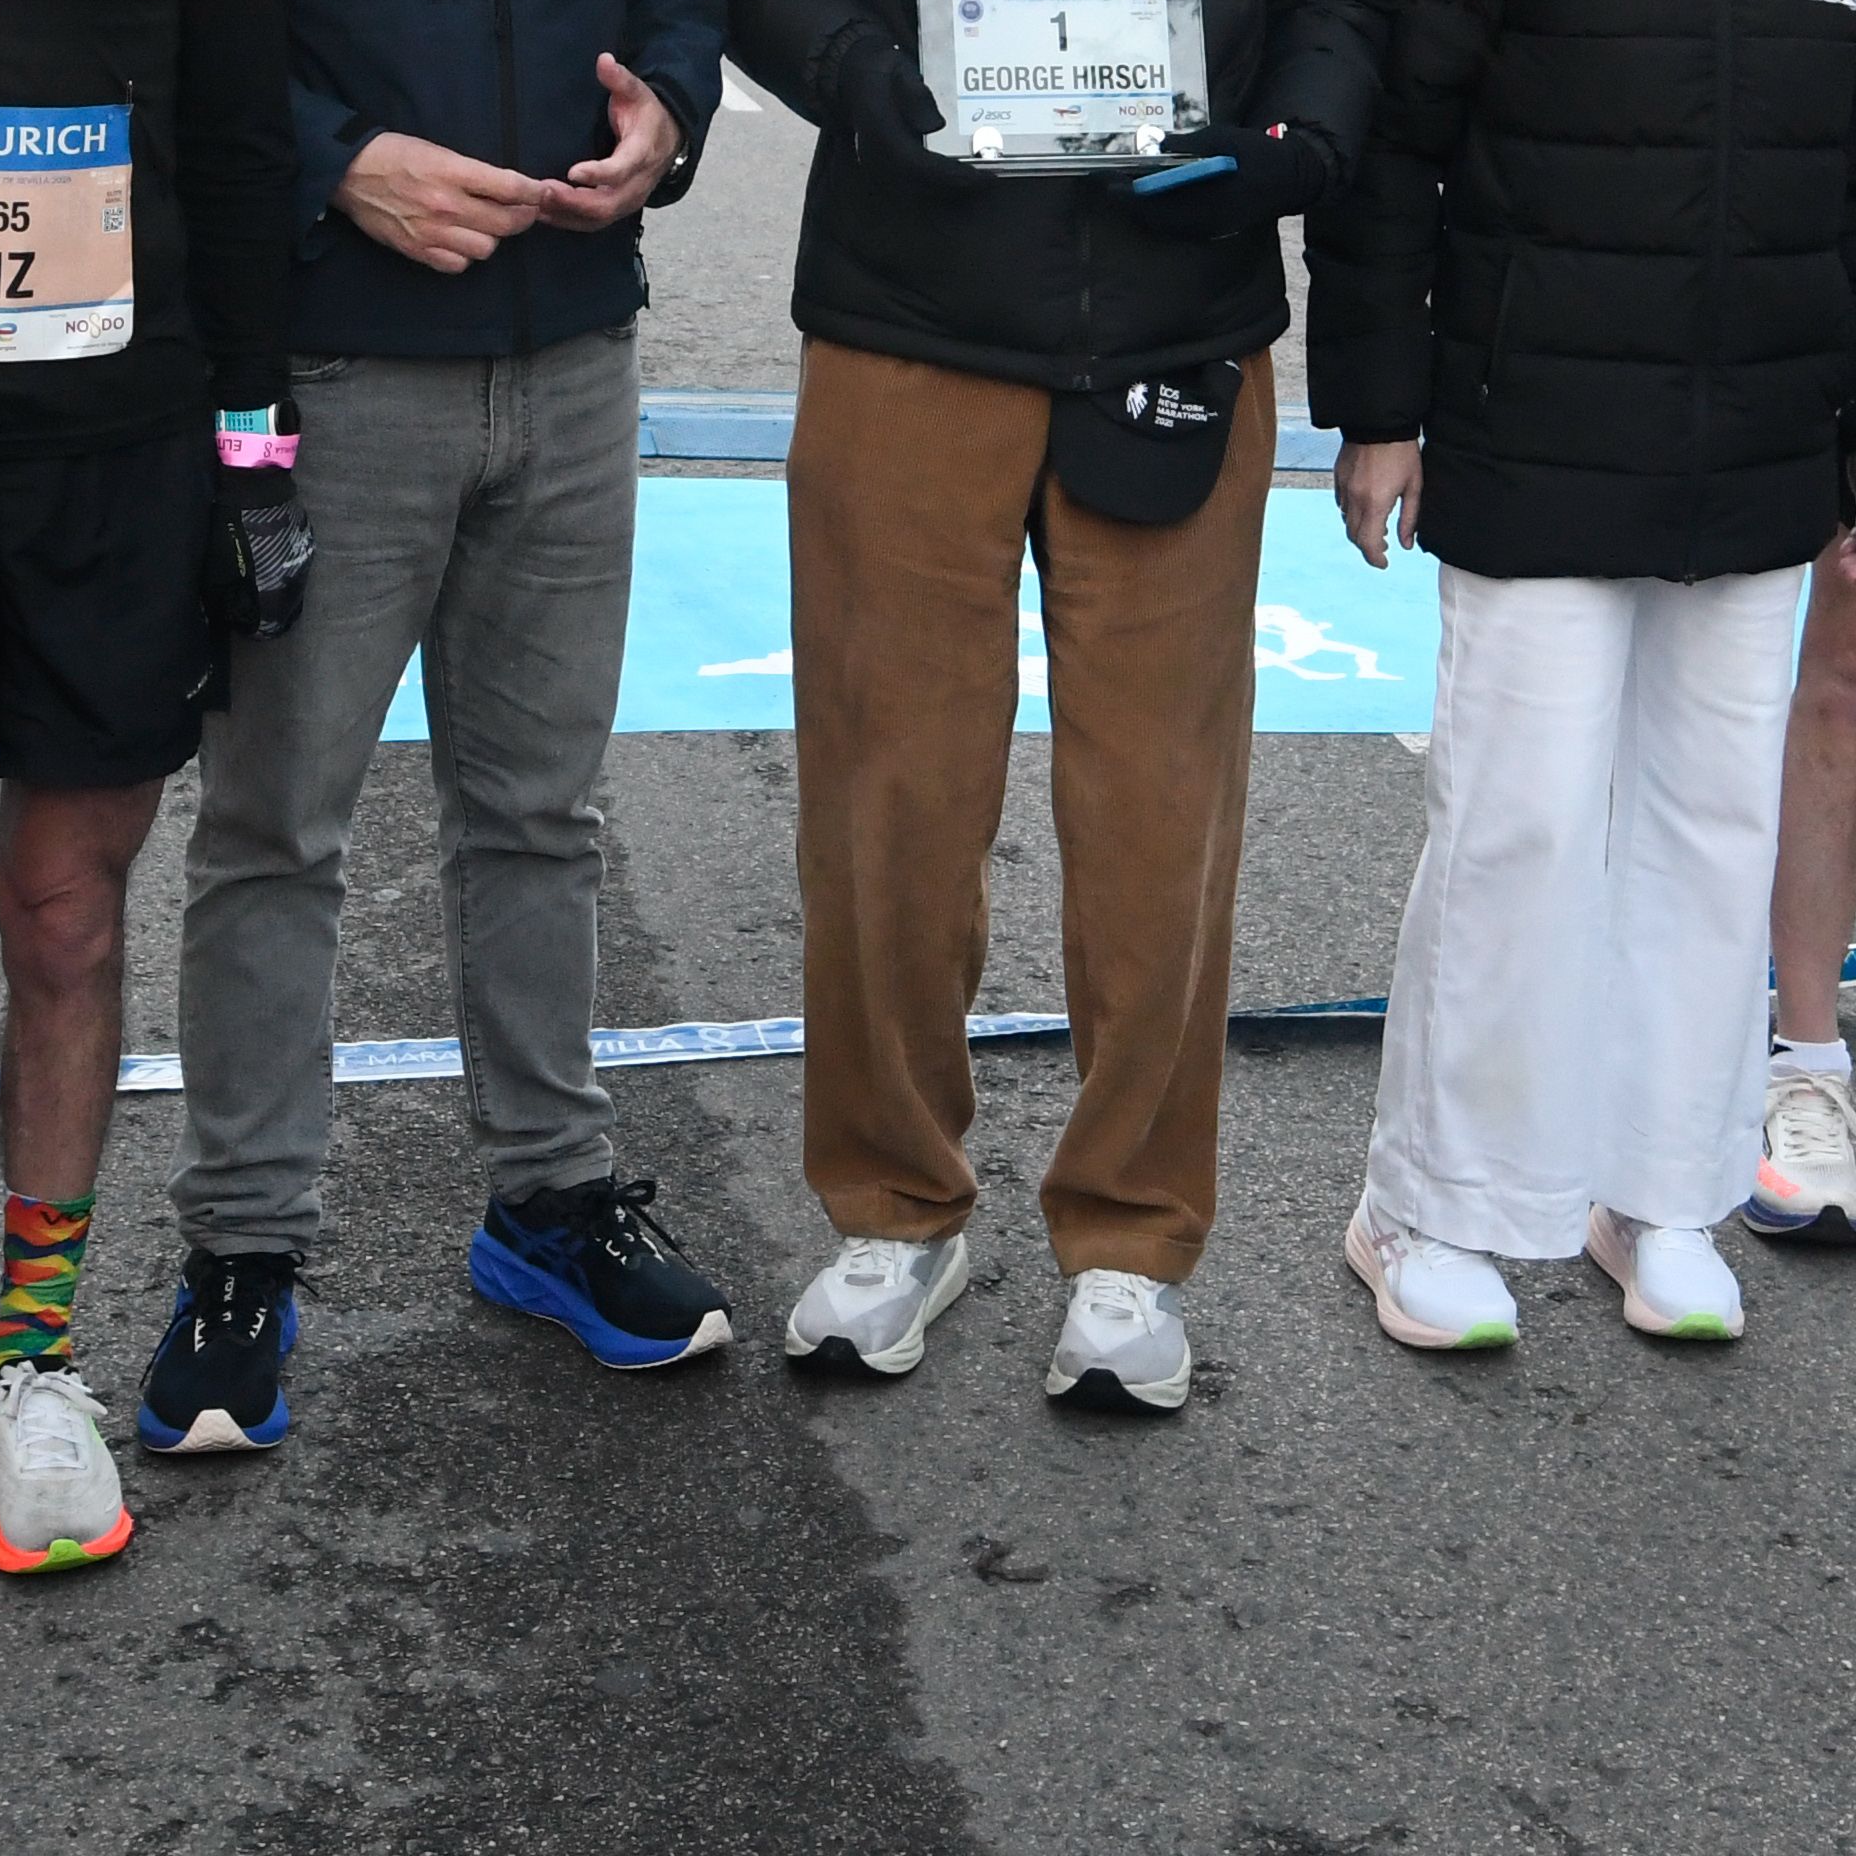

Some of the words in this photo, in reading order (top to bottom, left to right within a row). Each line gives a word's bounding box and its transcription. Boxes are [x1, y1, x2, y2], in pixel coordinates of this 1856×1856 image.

[1049, 10, 1069, 52] 1
[963, 65, 1065, 92] GEORGE
[1072, 64, 1166, 90] HIRSCH
[1156, 406, 1208, 422] MARATHON
[1157, 397, 1179, 410] NEW
[1180, 403, 1206, 413] YORK
